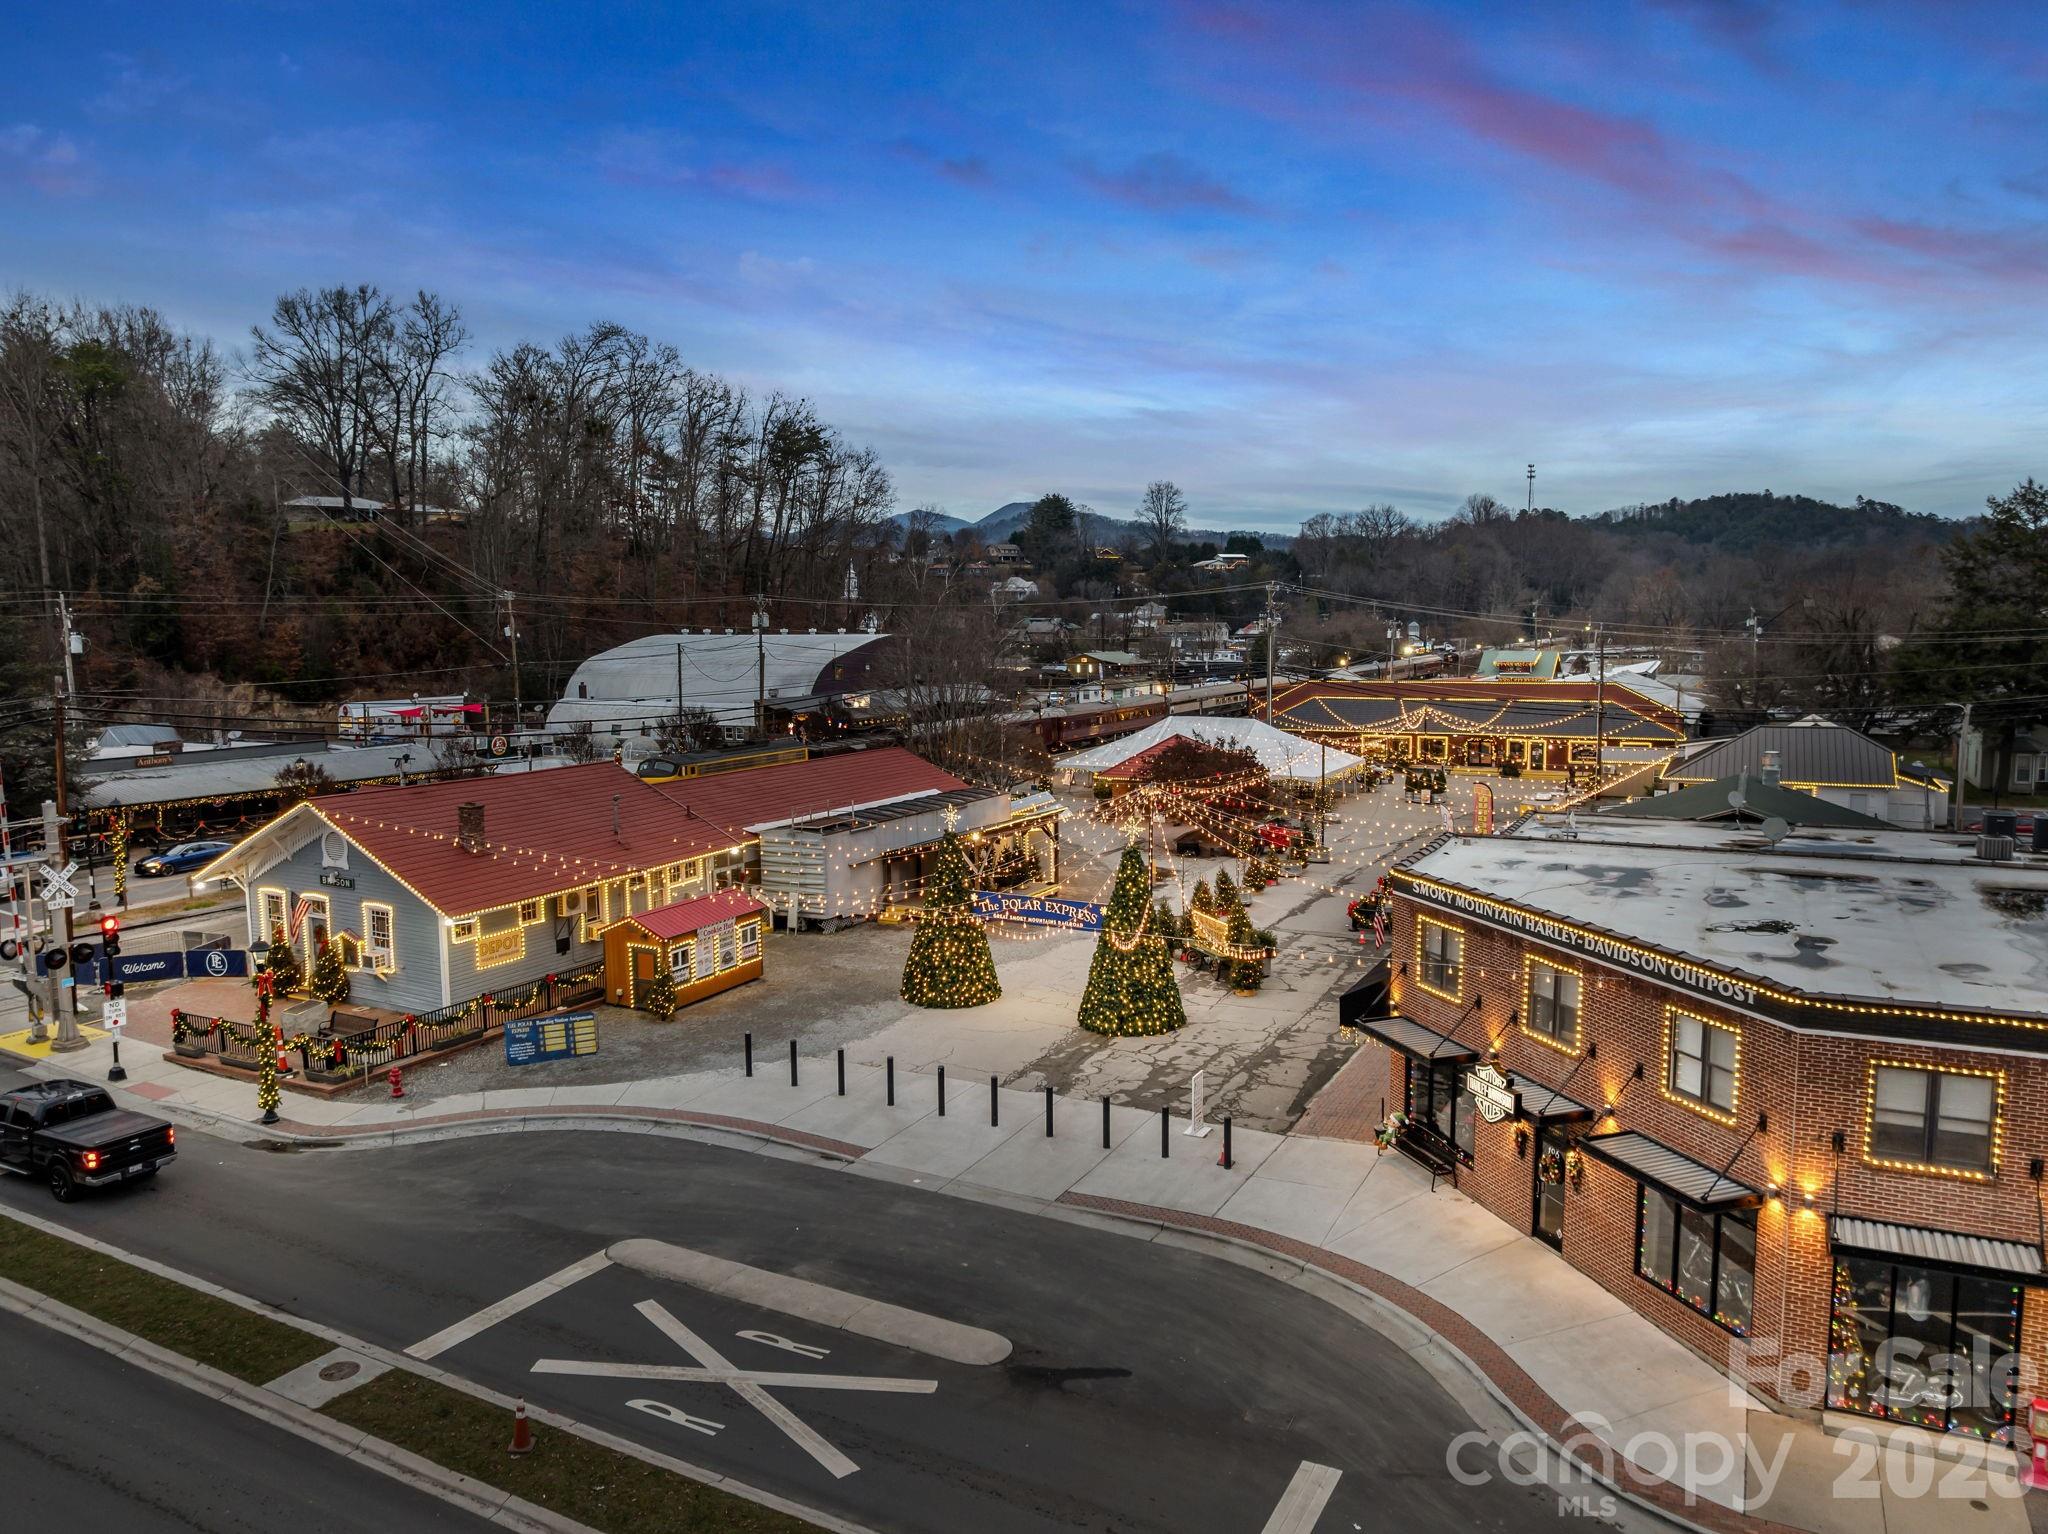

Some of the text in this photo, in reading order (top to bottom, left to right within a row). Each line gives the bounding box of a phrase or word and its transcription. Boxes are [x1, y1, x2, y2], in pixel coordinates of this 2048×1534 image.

[41, 866, 77, 895] RAILROAD
[322, 876, 350, 887] BSON
[979, 898, 1098, 924] The POLAR EXPRESS
[1028, 917, 1056, 925] MOUNTAINS
[703, 925, 722, 937] Cookie
[479, 934, 519, 956] DEPOT
[1412, 881, 1757, 1005] SMOKY MOUNTAIN HARLEY-DAVIDSON OUTPOST
[122, 960, 166, 975] Welcome
[1548, 1147, 1560, 1159] 106
